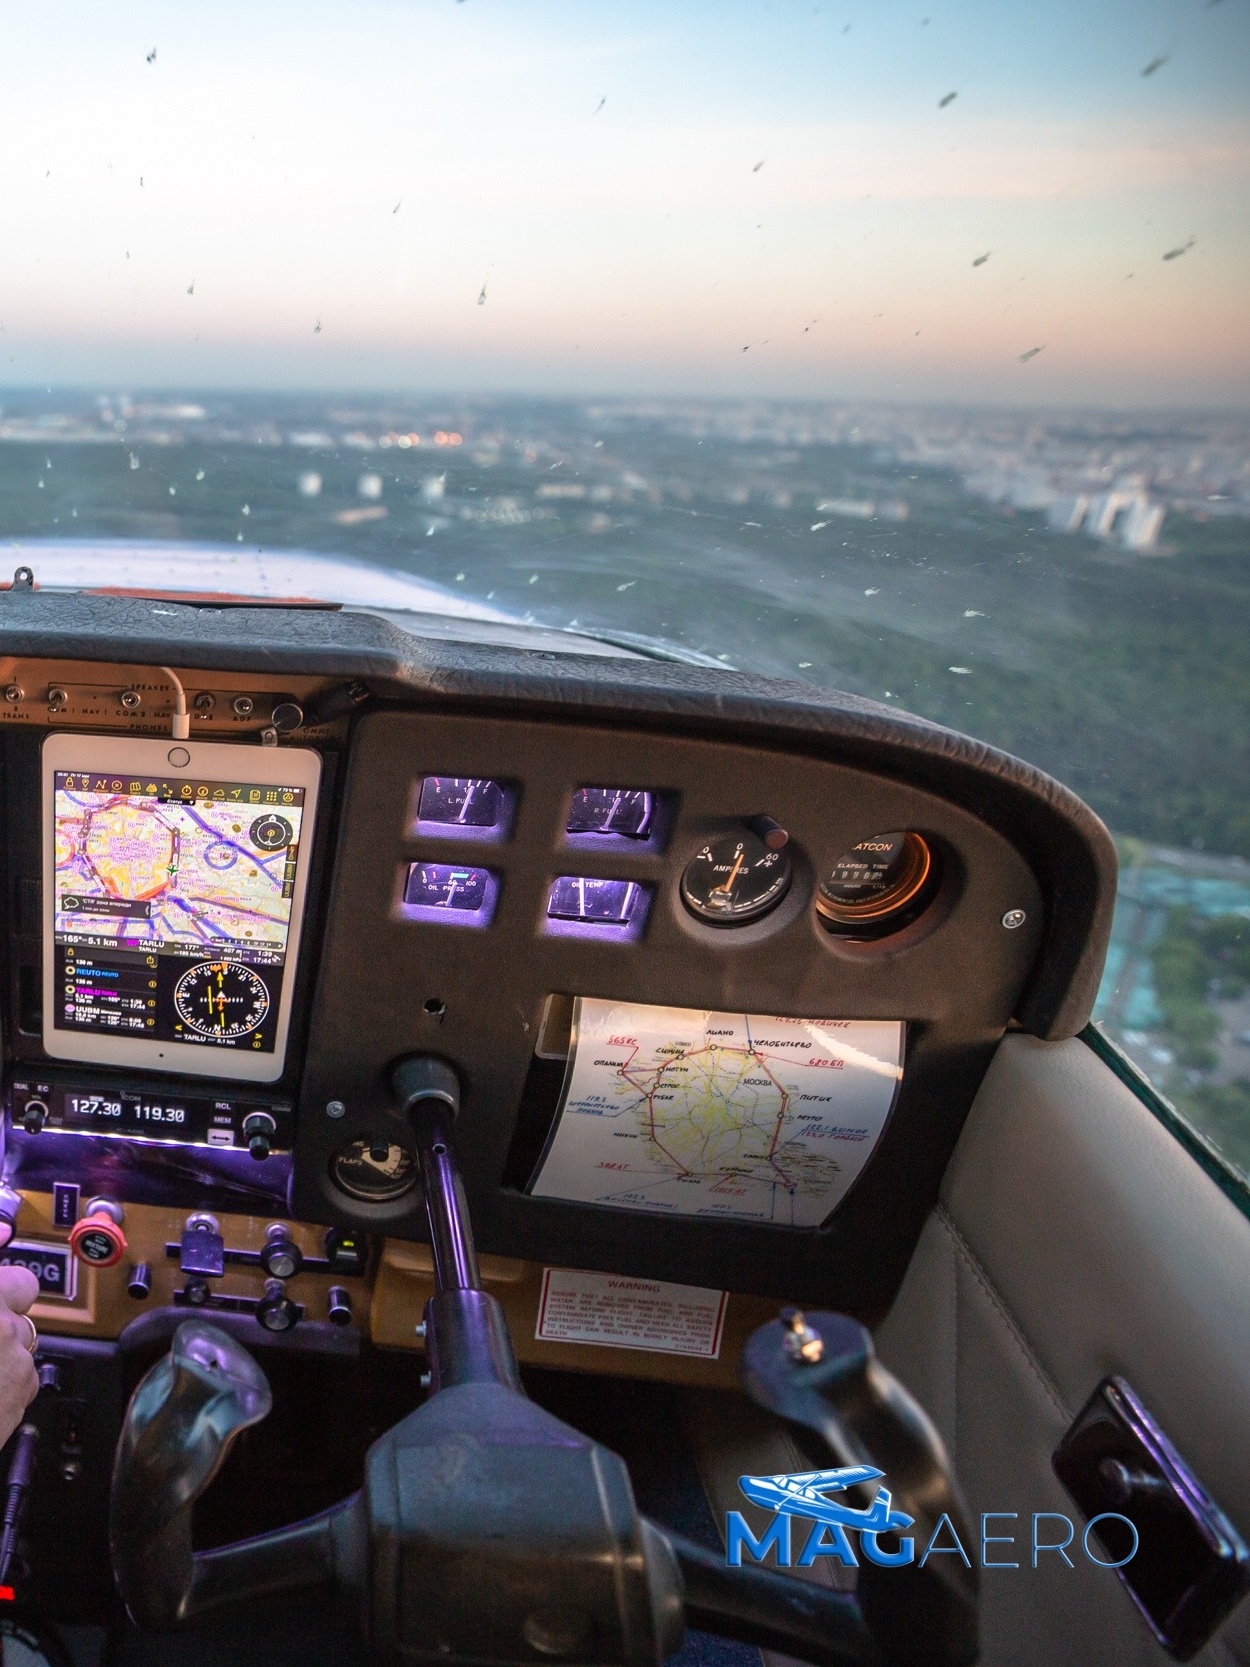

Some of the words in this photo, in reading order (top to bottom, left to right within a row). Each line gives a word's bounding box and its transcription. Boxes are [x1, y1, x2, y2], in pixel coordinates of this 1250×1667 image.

[130, 684, 170, 692] SPEAKER
[2, 712, 30, 720] TRANS
[116, 709, 138, 718] COM
[455, 797, 474, 805] FUL
[736, 842, 744, 850] 0
[765, 852, 779, 861] 60
[713, 864, 750, 875] AMPEES
[837, 862, 869, 870] ELAPSED
[442, 885, 465, 893] PRSS
[139, 940, 165, 948] TARLU
[743, 1078, 772, 1087] МОСКВА
[13, 1082, 29, 1090] DUAL
[37, 1084, 49, 1092] EC
[71, 1099, 122, 1116] 127.30
[134, 1105, 185, 1123] 119.30
[214, 1116, 232, 1124] MEM
[607, 1280, 661, 1293] WARNING
